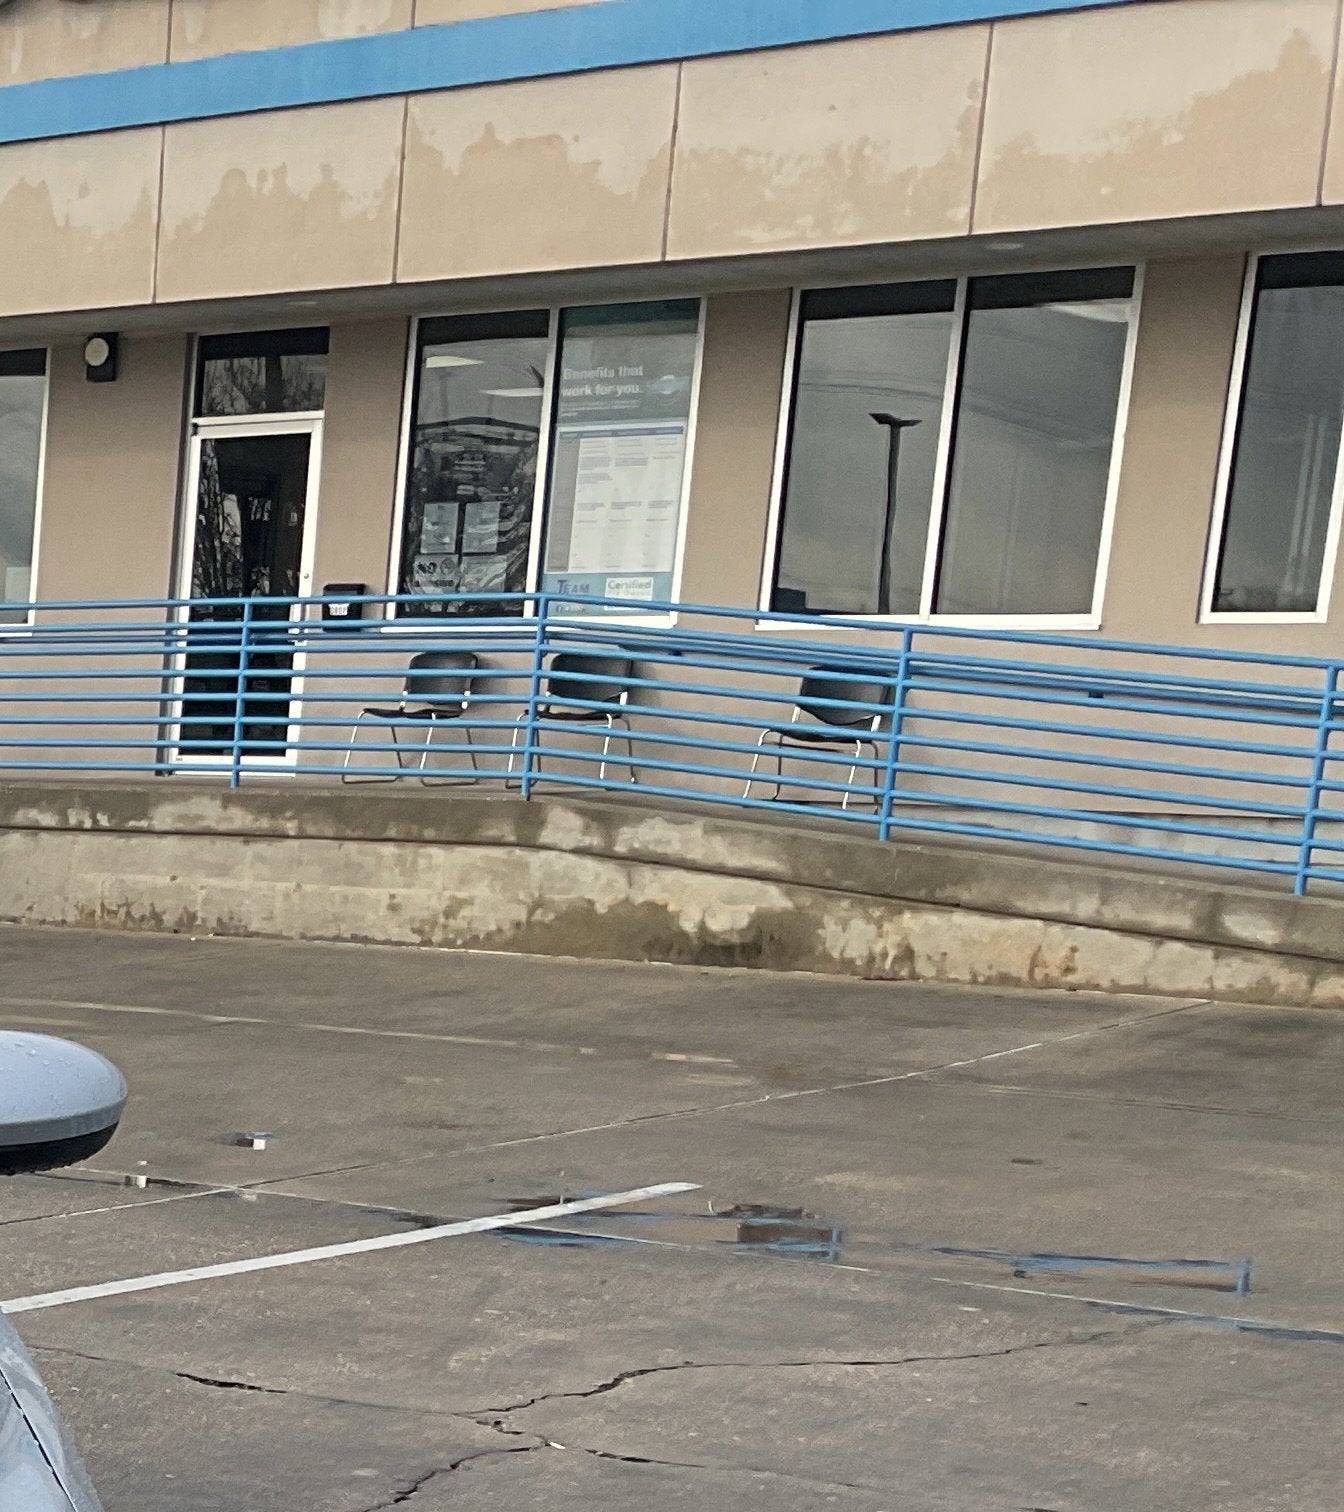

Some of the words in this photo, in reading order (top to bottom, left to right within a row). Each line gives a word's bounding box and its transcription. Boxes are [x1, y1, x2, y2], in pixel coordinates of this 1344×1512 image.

[563, 367, 615, 380] Benefits
[618, 365, 644, 377] that
[562, 385, 592, 397] work
[595, 384, 616, 396] for
[557, 580, 590, 594] TEAM
[607, 578, 652, 590] Certified
